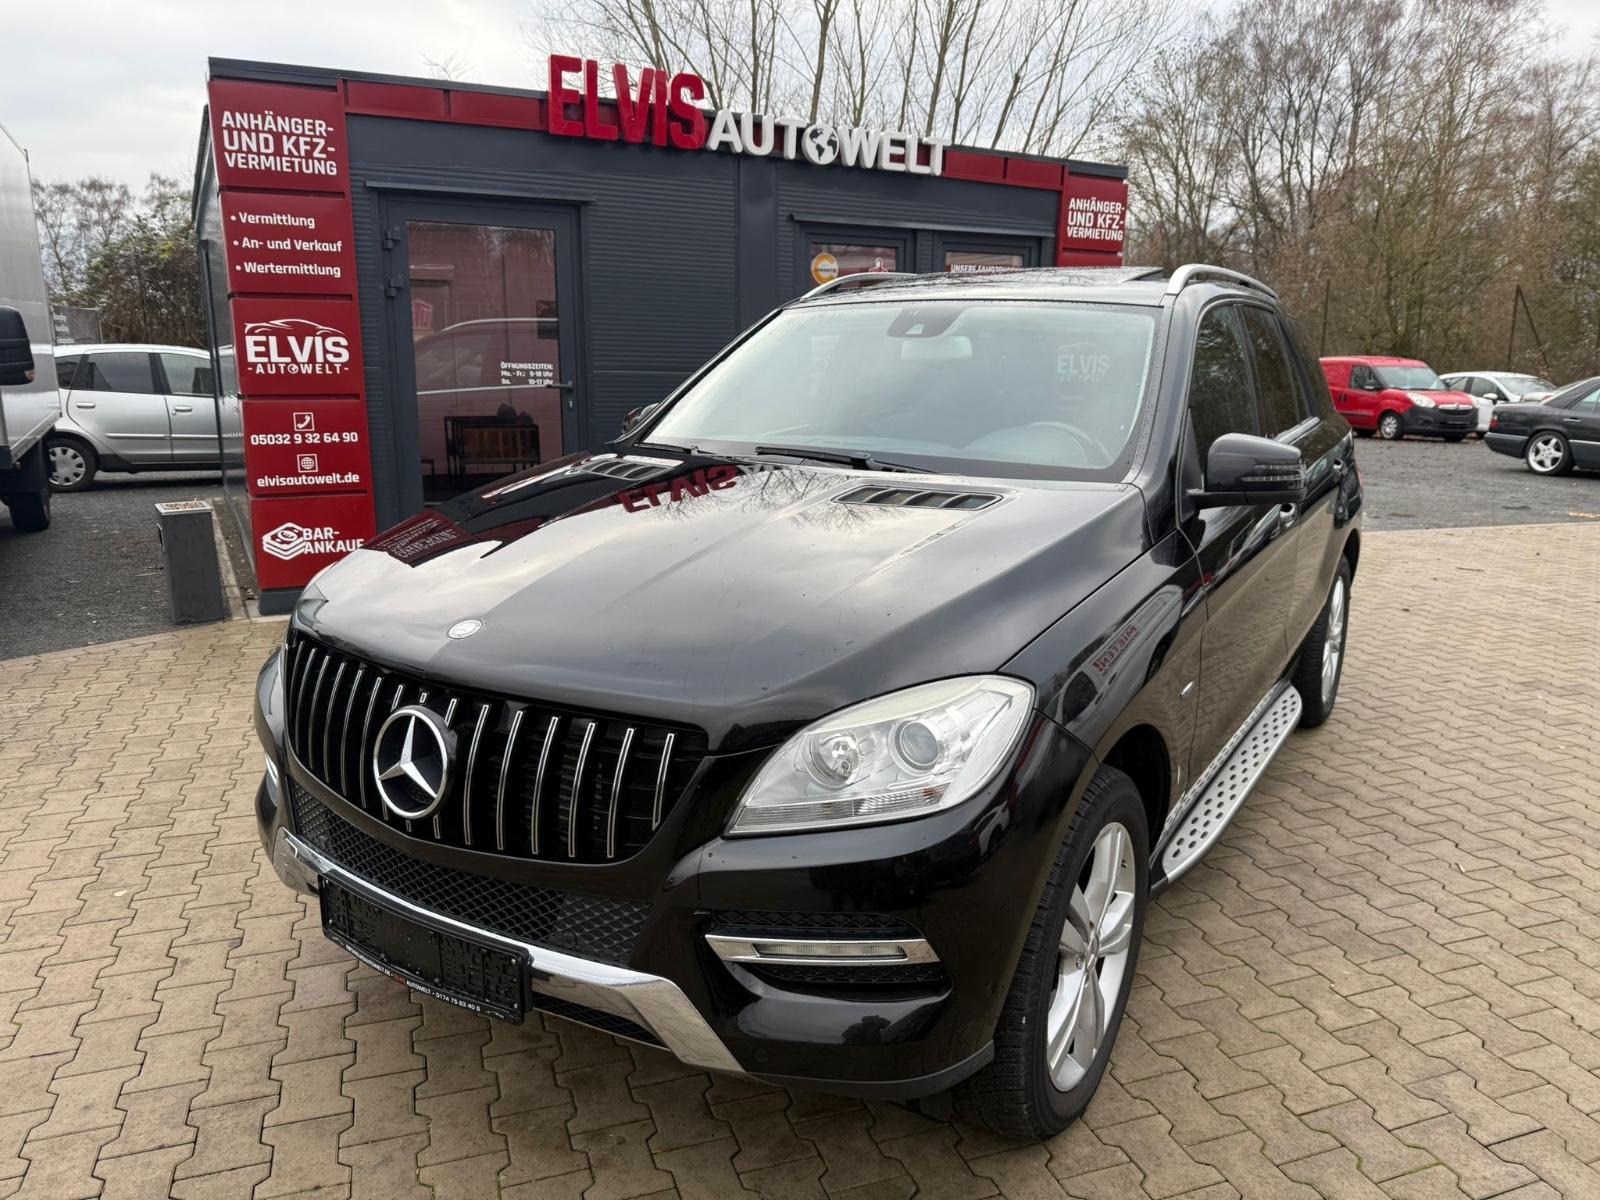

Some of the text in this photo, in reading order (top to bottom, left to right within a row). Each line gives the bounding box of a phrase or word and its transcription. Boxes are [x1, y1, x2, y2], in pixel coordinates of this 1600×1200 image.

[547, 54, 708, 150] ELVIS
[221, 110, 334, 136] ANHÄNGER-
[223, 129, 336, 159] UND KFZ-
[224, 152, 337, 175] VERMIETUNG
[1068, 197, 1125, 214] ANHÄNGER-
[239, 212, 316, 229] Vermittlung
[1068, 211, 1124, 229] UND KFZ-
[1067, 226, 1123, 241] VERMIETUNG
[242, 237, 342, 252] An- und Verkauf
[244, 262, 341, 278] Wertermittlung
[245, 335, 349, 363] ELVIS
[251, 432, 358, 445] 05032 9 32 64 90
[257, 472, 360, 487] elvisautowelt.de
[303, 527, 340, 540] BAR-
